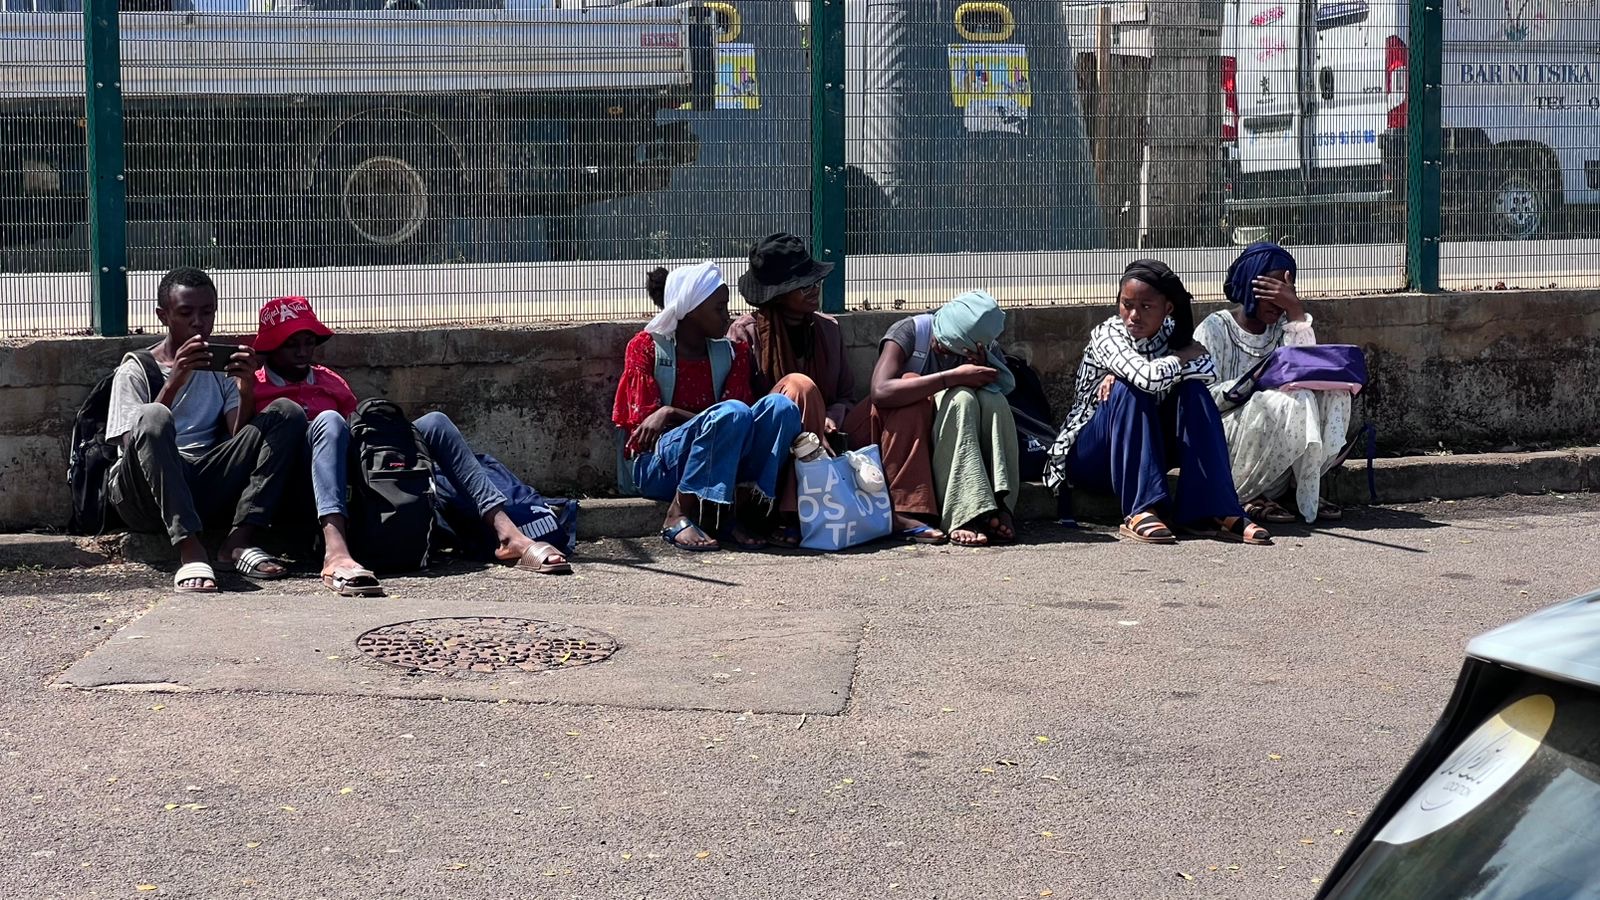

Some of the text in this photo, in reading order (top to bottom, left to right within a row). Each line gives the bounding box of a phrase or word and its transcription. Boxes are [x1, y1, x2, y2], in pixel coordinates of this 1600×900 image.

[1461, 64, 1502, 84] BAR
[803, 464, 839, 494] LA
[519, 515, 558, 539] UMA
[825, 521, 857, 546] TE
